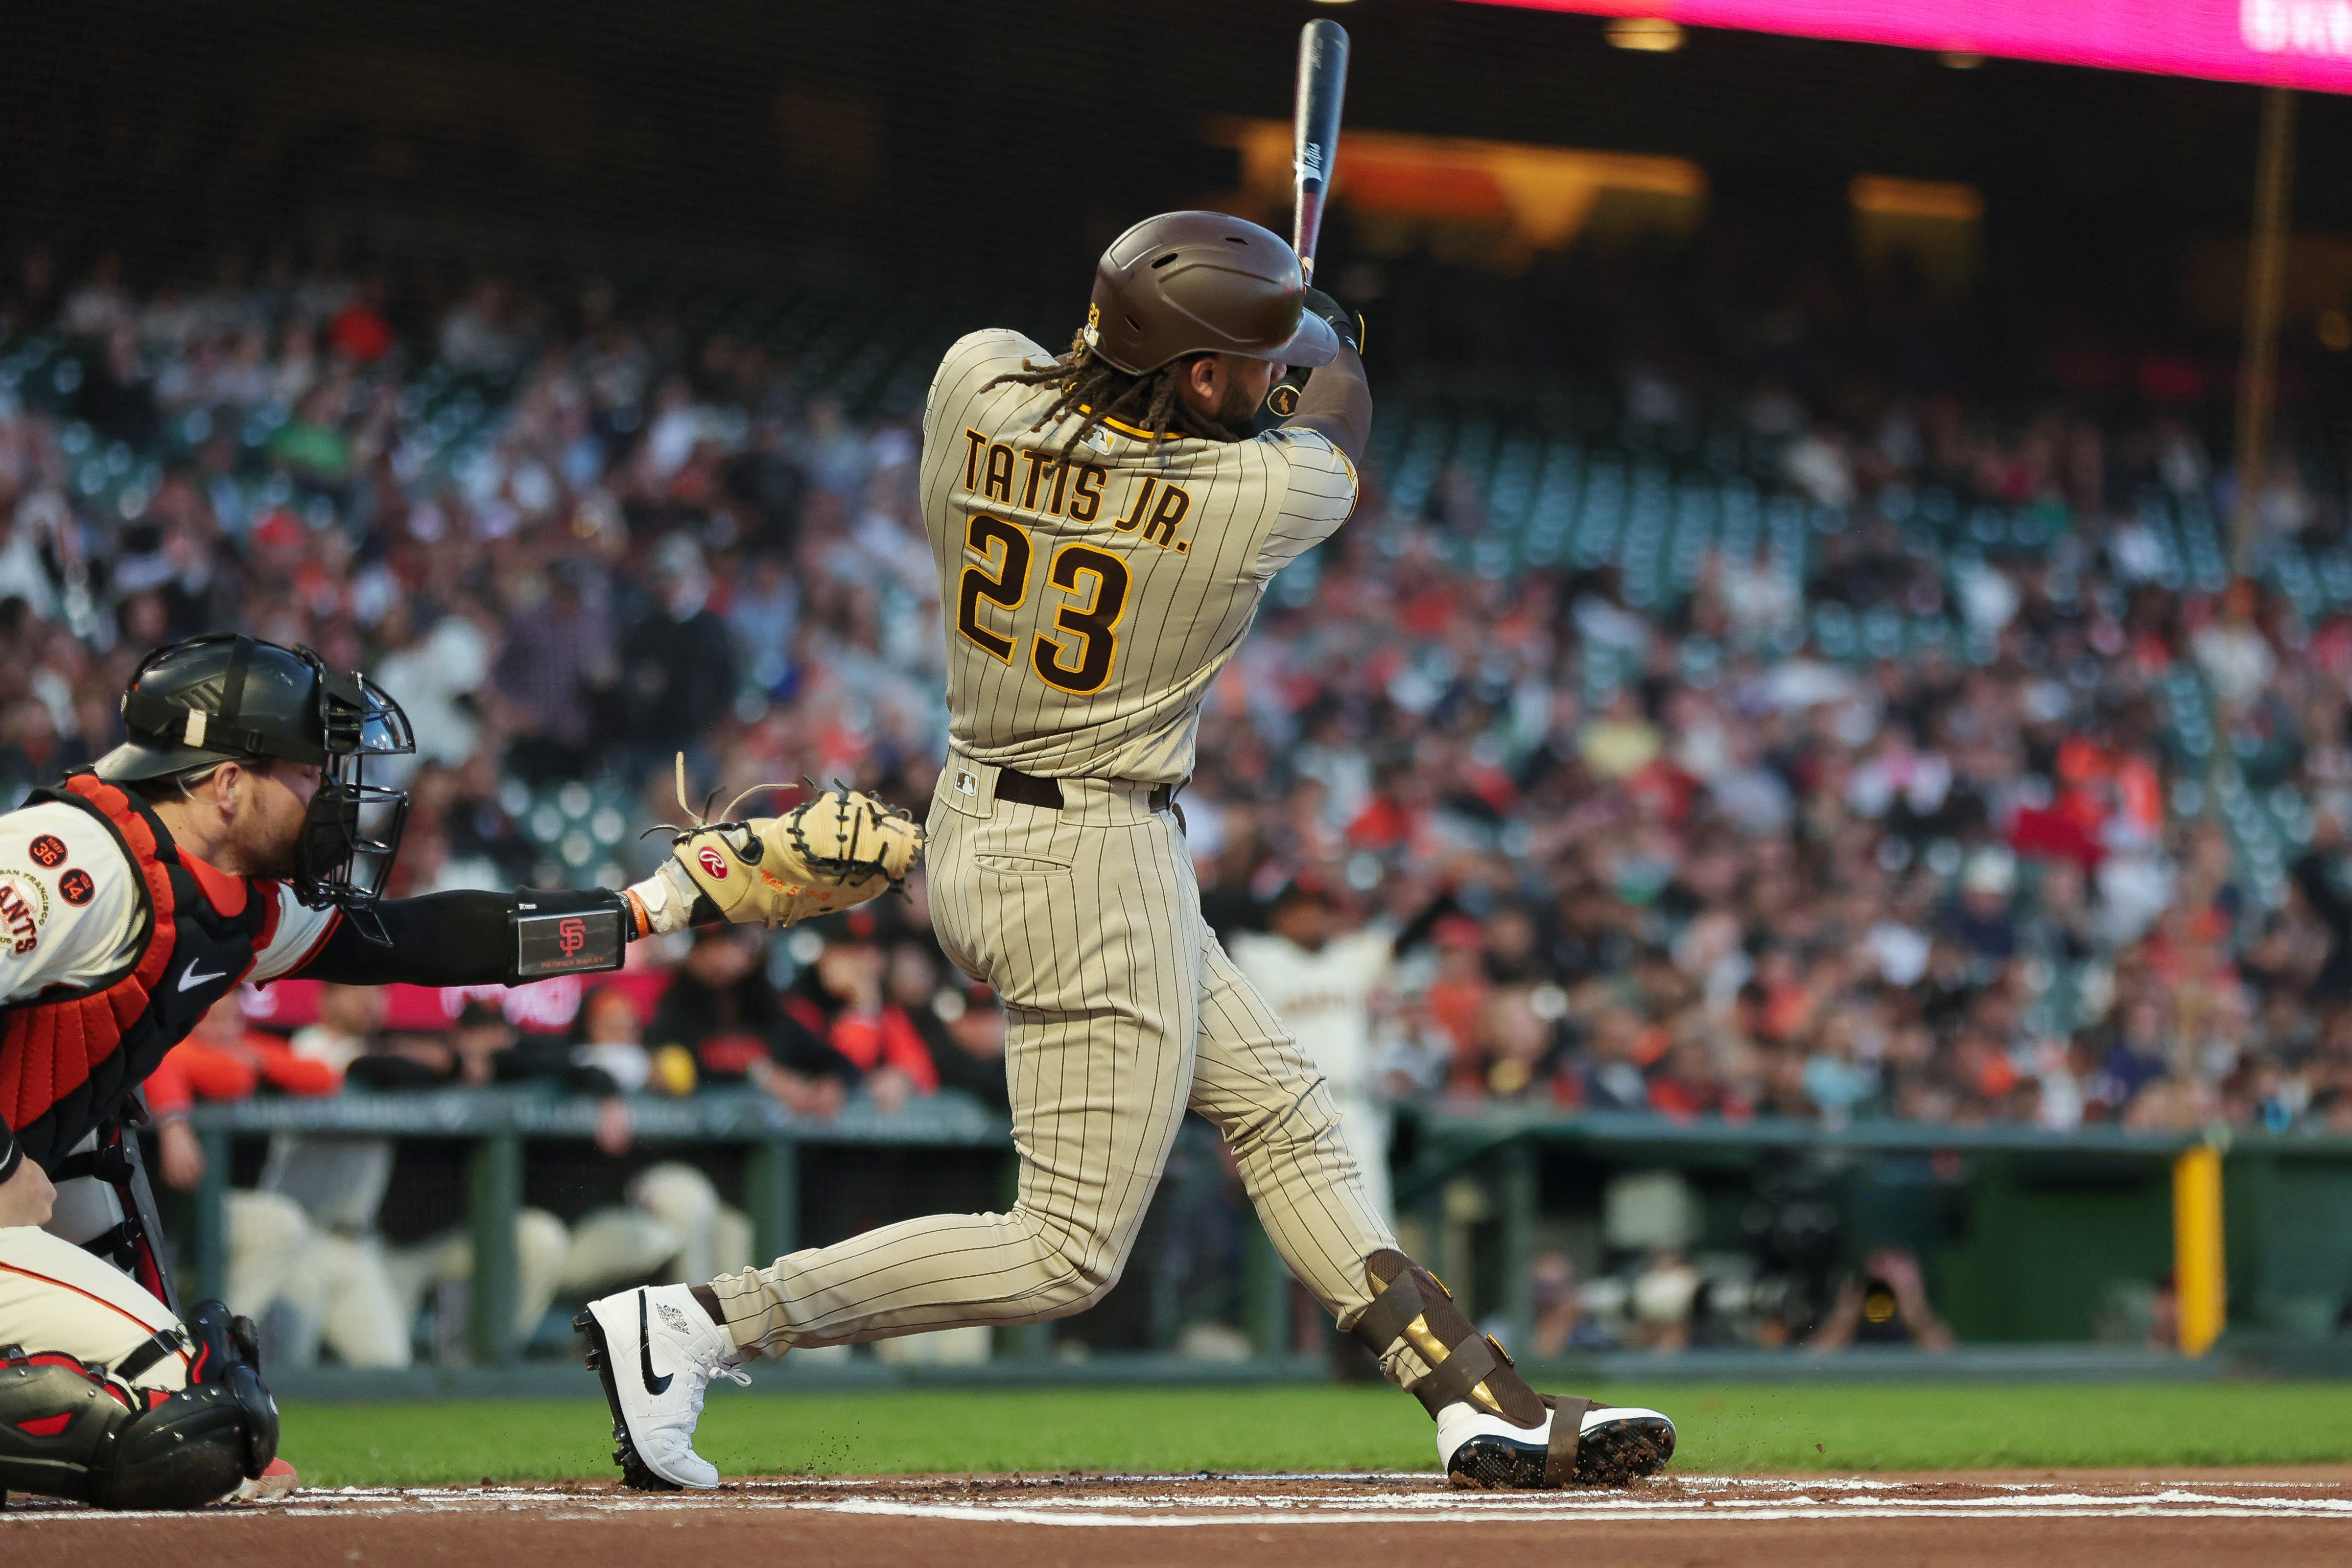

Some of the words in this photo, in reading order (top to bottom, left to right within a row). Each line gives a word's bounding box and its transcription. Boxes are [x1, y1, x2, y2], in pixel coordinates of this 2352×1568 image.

[1088, 302, 1101, 329] 23
[964, 426, 1108, 523] TATIS
[1113, 476, 1192, 554] JR.
[956, 511, 1132, 696] 23
[33, 841, 58, 865] 36
[24, 872, 49, 926] FRANCISCO
[64, 877, 85, 900] 14
[559, 917, 587, 958] SF
[541, 960, 575, 968] PATRICK
[576, 957, 605, 965] BAILEY
